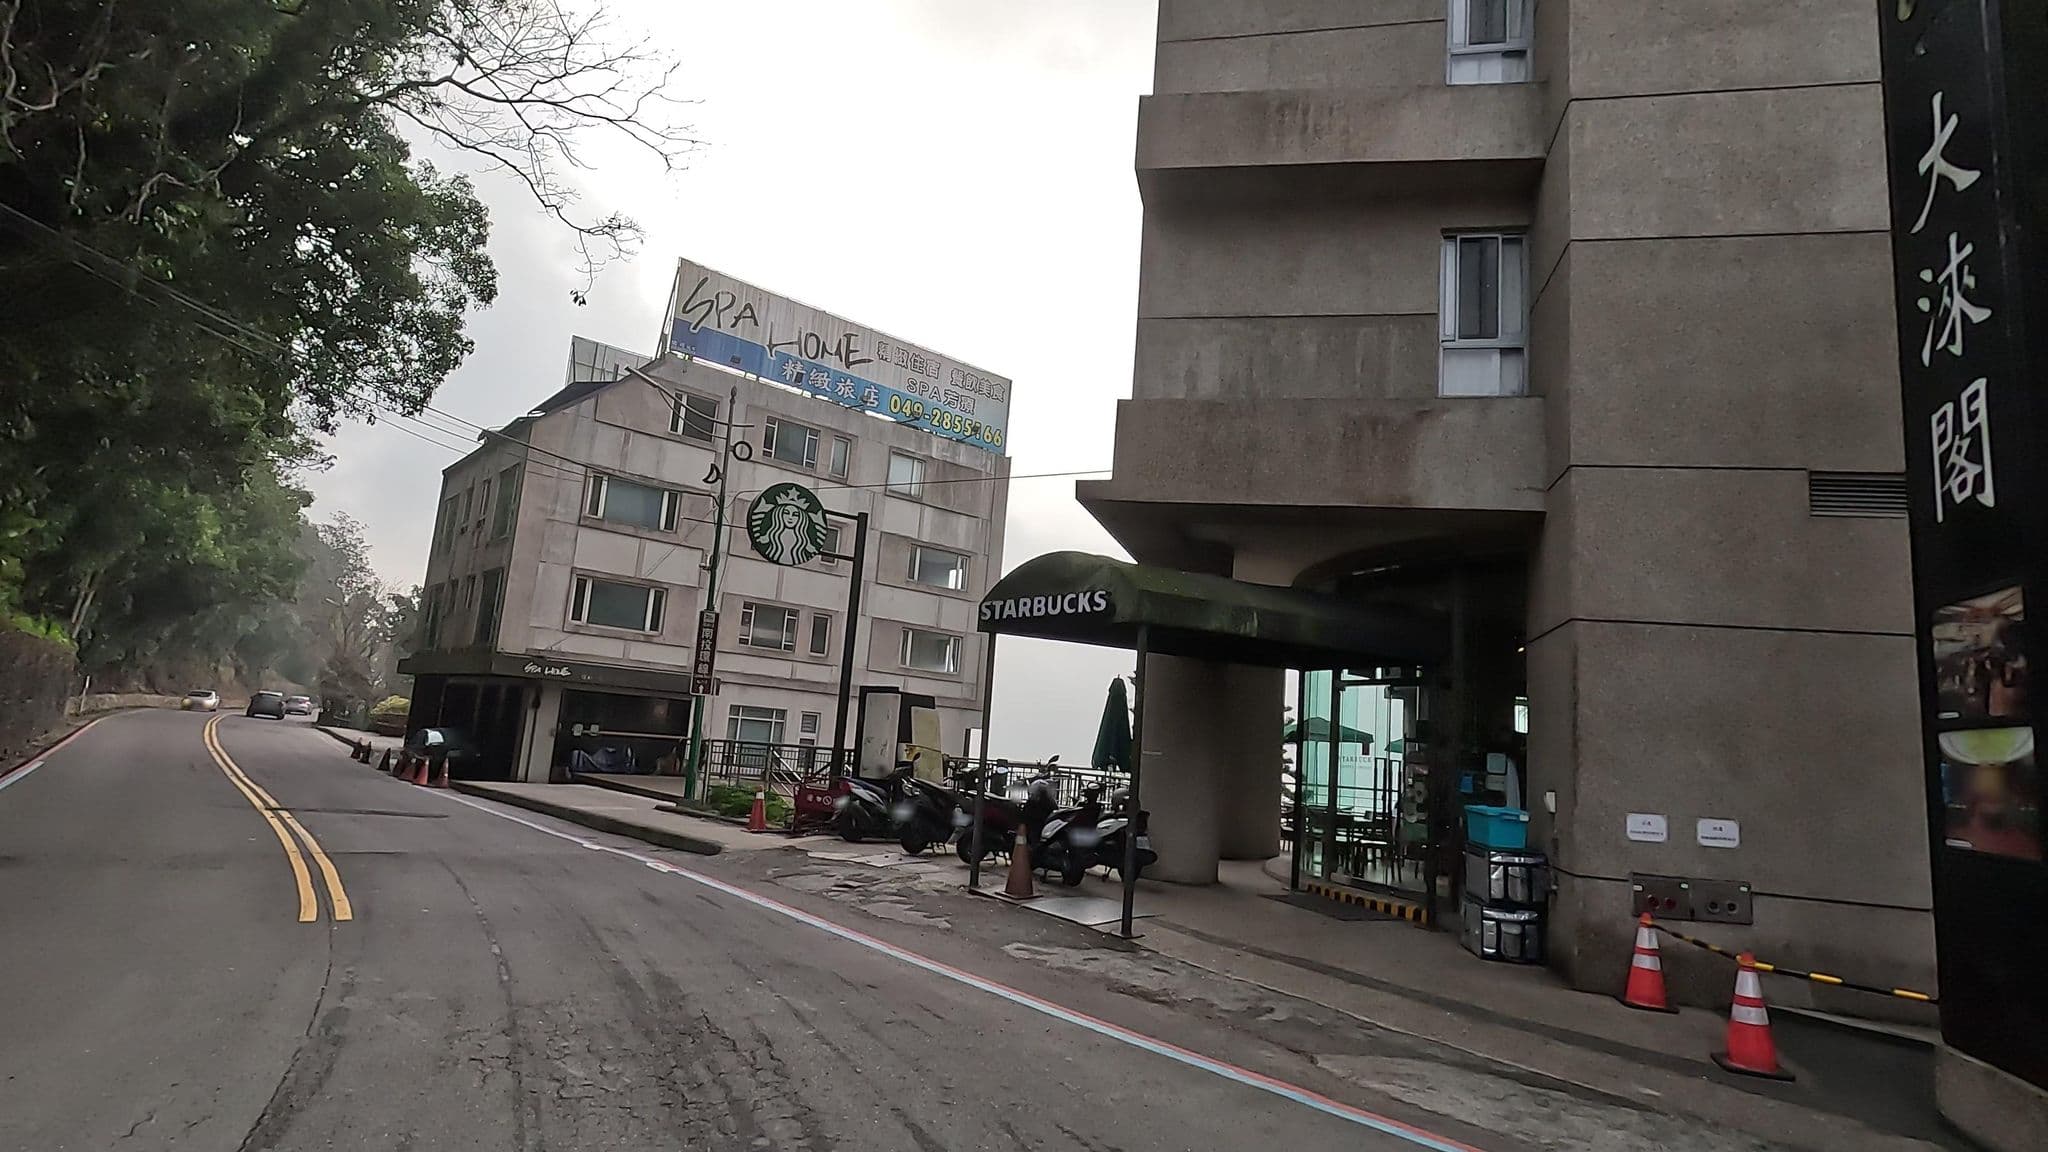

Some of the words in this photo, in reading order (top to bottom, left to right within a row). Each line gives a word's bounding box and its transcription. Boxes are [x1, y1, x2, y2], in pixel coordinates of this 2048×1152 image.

[681, 276, 760, 331] SPA
[766, 321, 875, 370] HOME
[1910, 90, 1996, 524] 大淶閣
[782, 358, 880, 408] 精緻旅店
[950, 367, 1005, 402] 餐飲美食
[980, 591, 1107, 620] STARBUCKS
